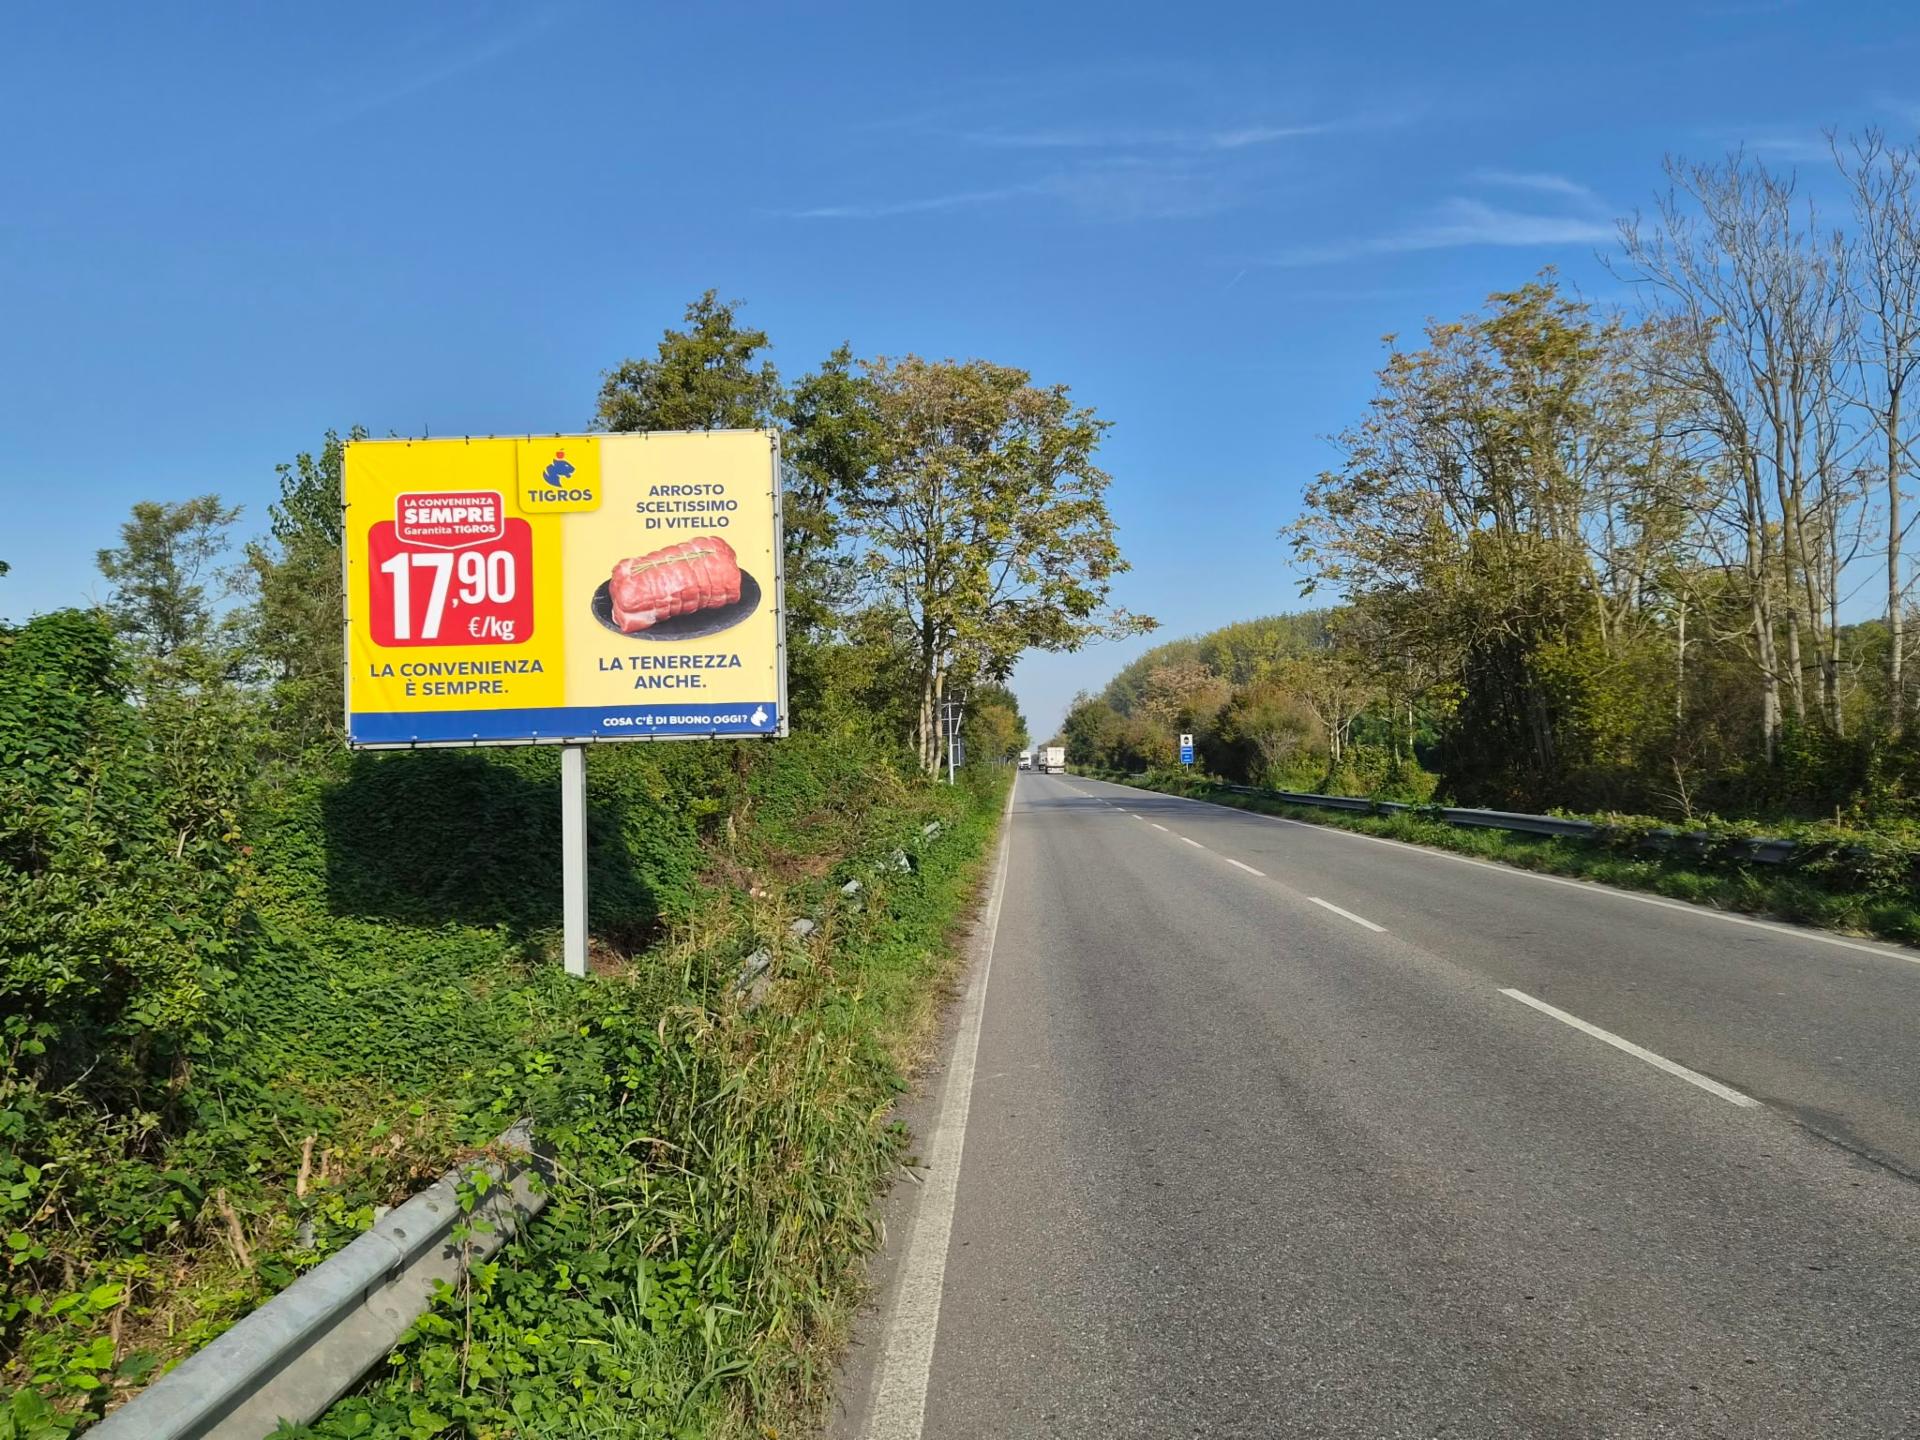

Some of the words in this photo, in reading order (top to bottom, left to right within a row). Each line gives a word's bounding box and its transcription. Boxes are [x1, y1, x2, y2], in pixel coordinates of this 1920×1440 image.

[527, 488, 593, 502] TIGROS
[648, 484, 725, 497] ARROSTO
[404, 499, 417, 507] LA
[418, 497, 494, 507] CONVENIENZA
[636, 499, 738, 514] SCELTISSIMO
[404, 507, 495, 524] SEMPRE
[645, 517, 661, 530] DI
[665, 516, 730, 529] VITELLO
[404, 527, 452, 535] Garantita
[453, 524, 496, 534] TIGROS
[381, 550, 516, 641] 17,90
[468, 616, 515, 641] €/kg
[370, 663, 395, 678] LA
[400, 659, 544, 677] CONVENIENZA
[599, 657, 624, 672] LA
[630, 654, 742, 670] TENEREZZA
[405, 678, 416, 697] È
[422, 680, 509, 696] SEMPRE.
[634, 674, 707, 690] ANCHE.
[603, 717, 633, 727] COSA
[635, 714, 653, 725] C'È
[655, 716, 667, 725] DI
[669, 715, 711, 725] BUONO
[712, 714, 748, 724] OGGI?
